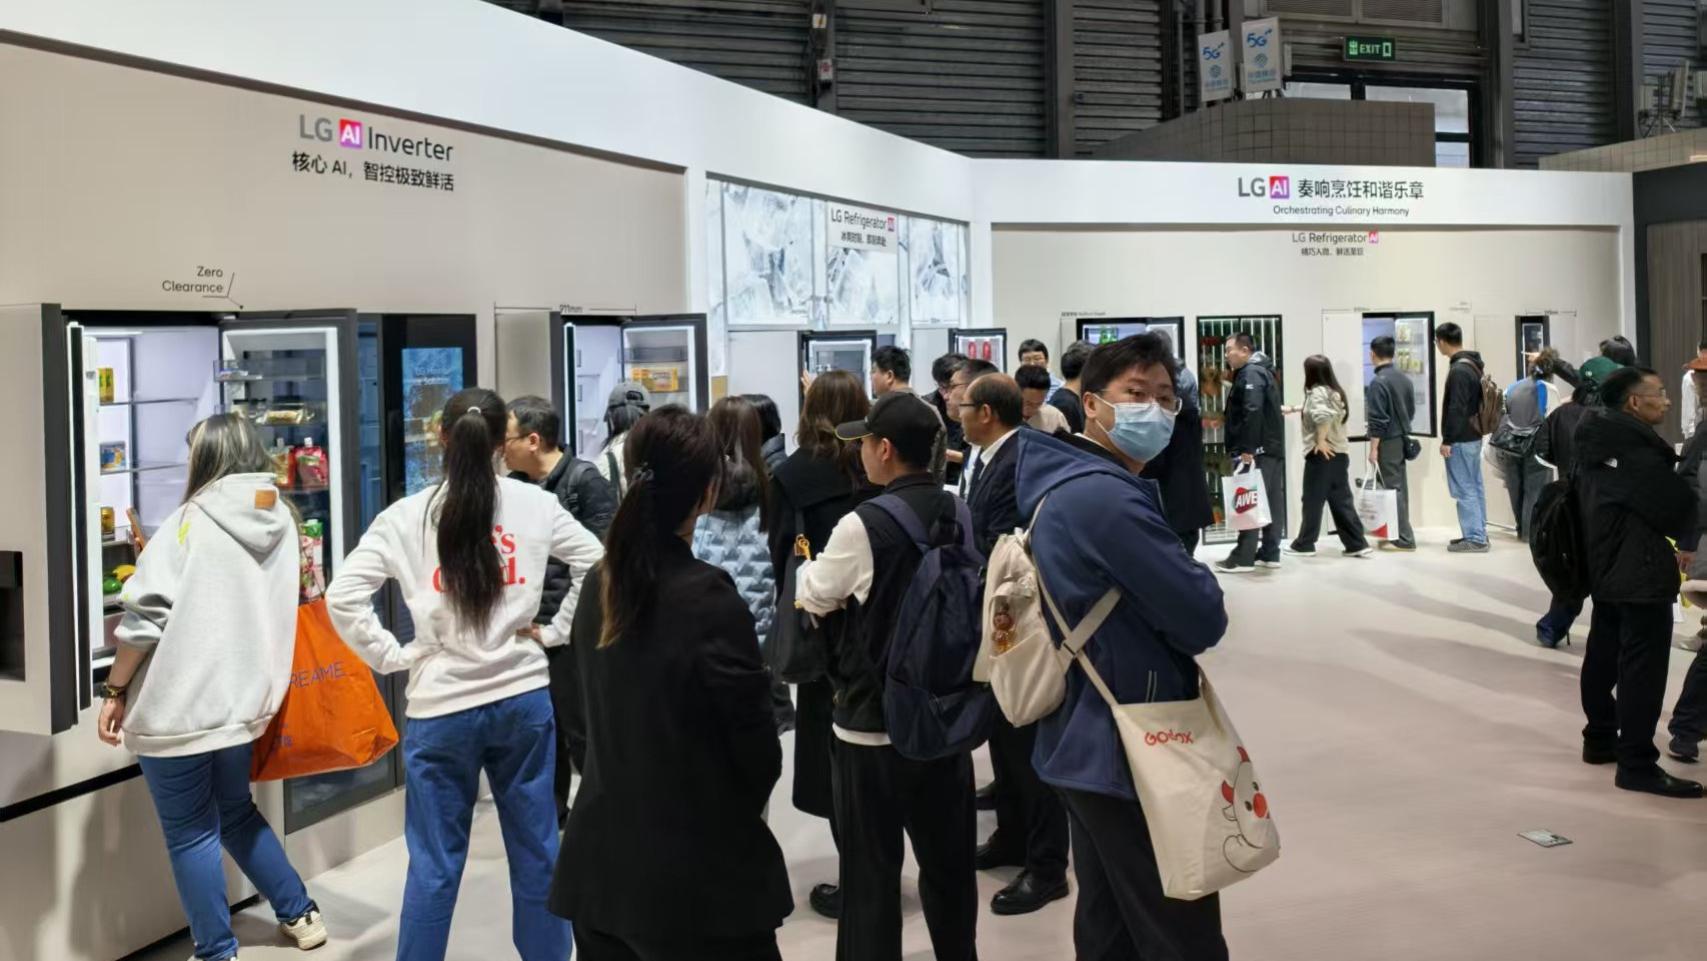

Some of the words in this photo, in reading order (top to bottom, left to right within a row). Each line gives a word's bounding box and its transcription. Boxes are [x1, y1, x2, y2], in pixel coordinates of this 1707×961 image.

[1247, 32, 1267, 48] 5G
[1202, 46, 1220, 60] 5G
[1360, 44, 1380, 54] EXIT
[300, 115, 333, 142] LG
[340, 121, 361, 147] AI
[368, 126, 454, 161] Inverter
[292, 151, 328, 174] 核心
[1238, 177, 1266, 197] LG
[1271, 178, 1288, 198] AI
[1298, 178, 1424, 200] 奏响烹饪和谐乐章
[831, 208, 842, 223] LG
[844, 210, 886, 229] Refrigerator
[1273, 205, 1334, 217] Orchestrating
[1335, 205, 1371, 217] Culinary
[1372, 206, 1409, 217] Harmony
[1292, 232, 1306, 243] LG
[1309, 232, 1367, 244] Refrigerator
[197, 265, 223, 278] Zero
[162, 280, 224, 293] Clearance
